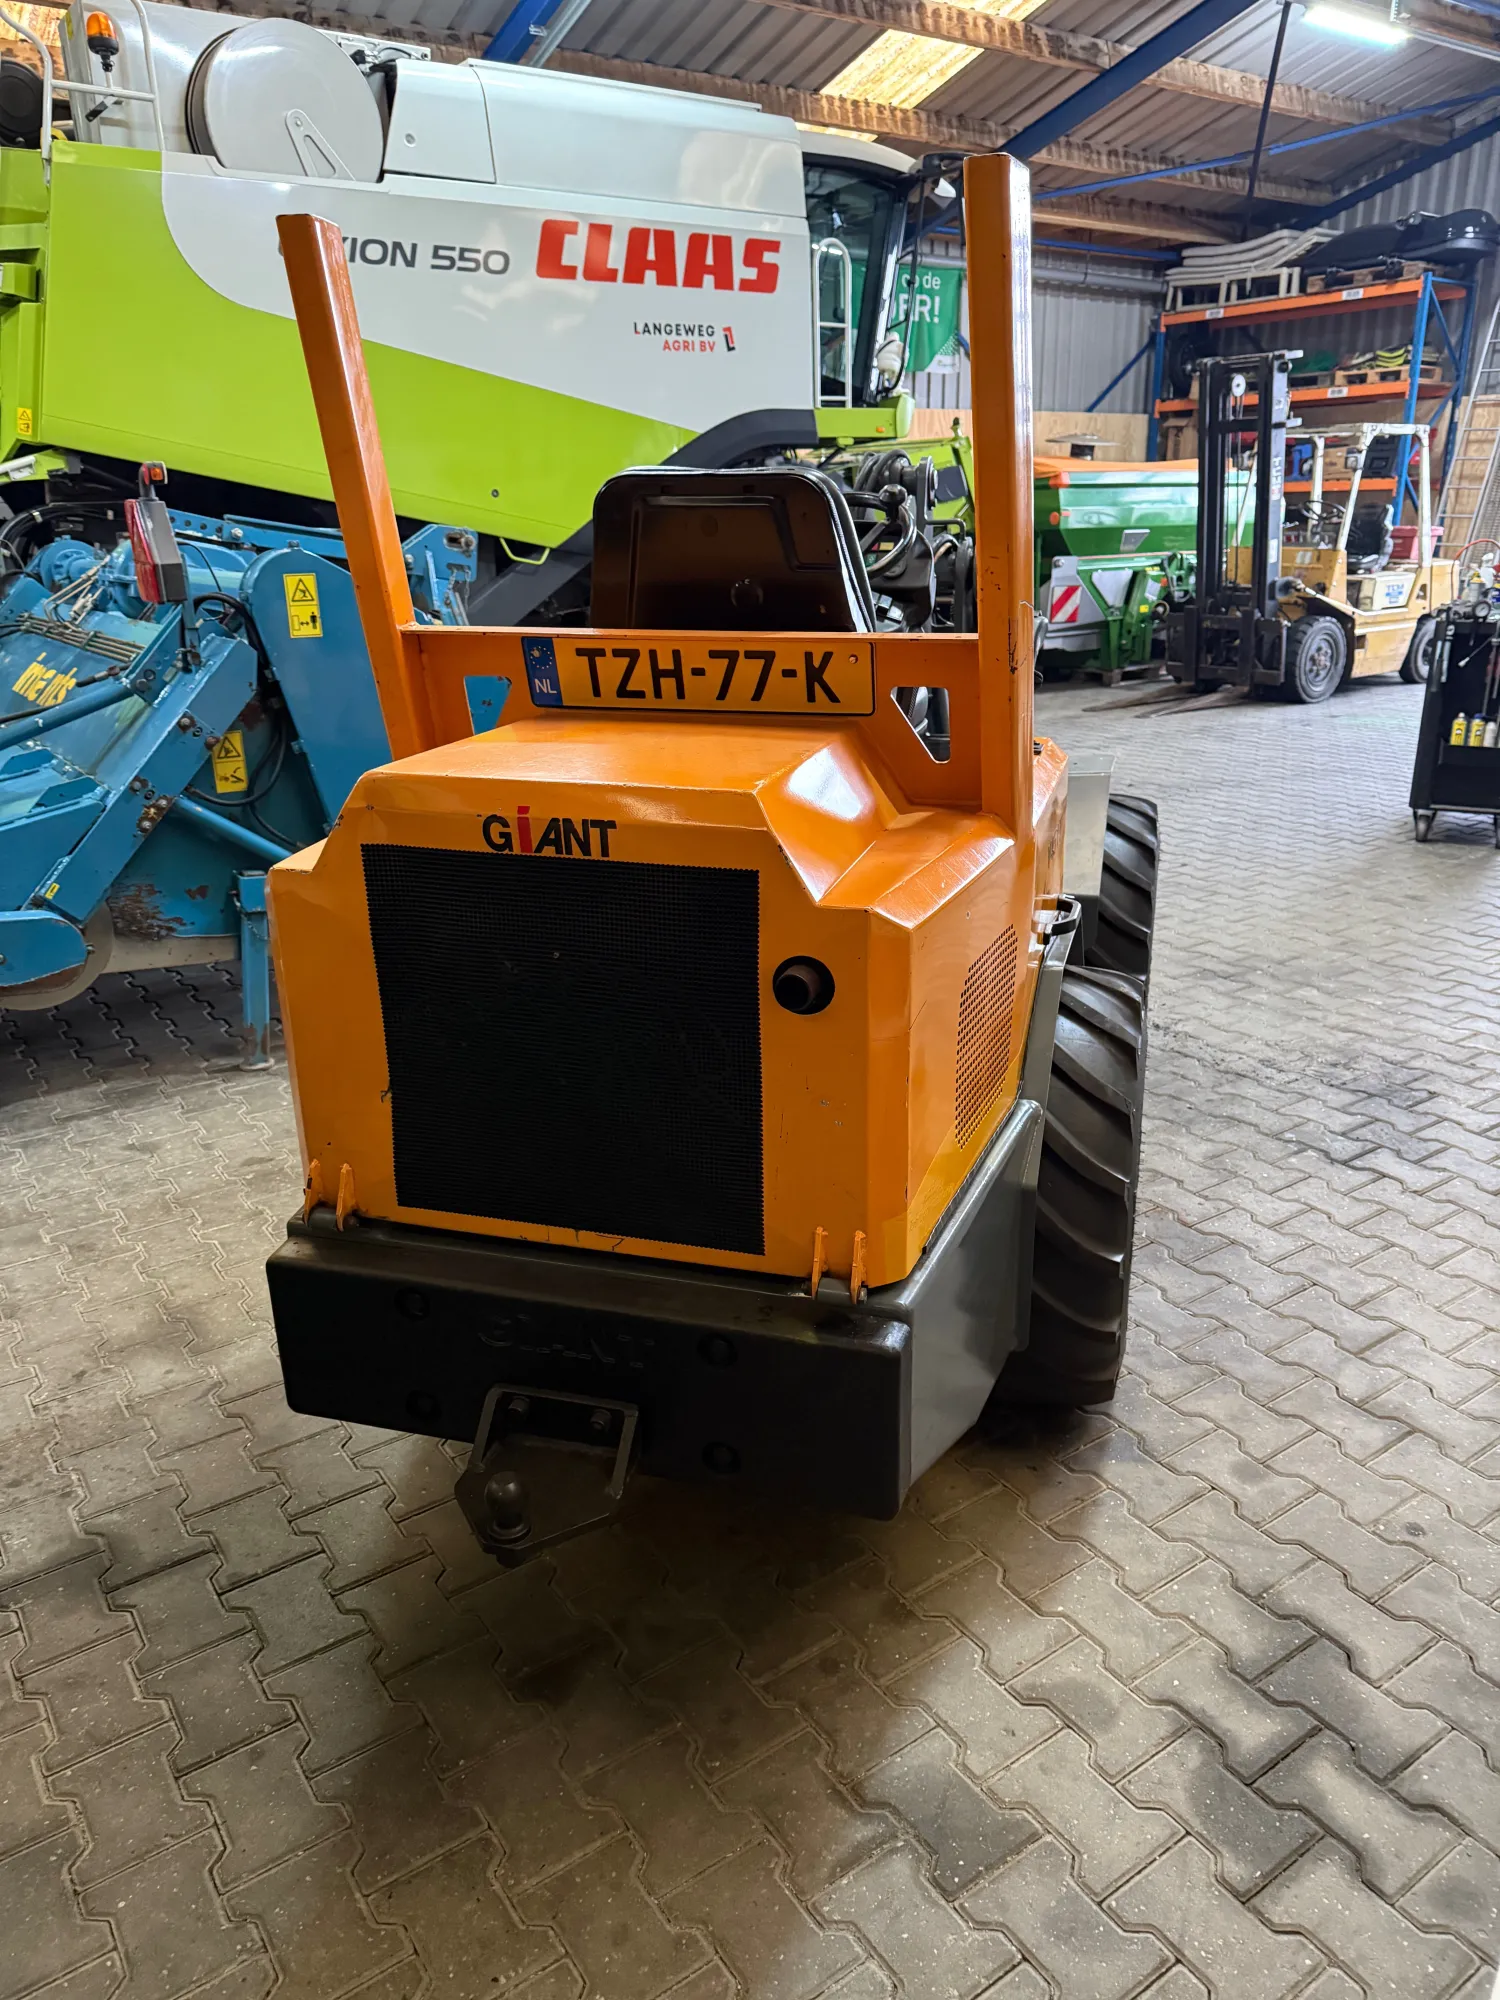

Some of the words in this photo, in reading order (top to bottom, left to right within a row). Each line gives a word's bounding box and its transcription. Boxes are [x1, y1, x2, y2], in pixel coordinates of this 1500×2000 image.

[430, 244, 510, 275] 550
[536, 219, 781, 294] CLAAS
[922, 271, 941, 290] de
[634, 321, 715, 337] LANGEWEG
[662, 339, 695, 352] AGRI
[699, 340, 716, 352] BV
[575, 647, 841, 704] TZH-77-K
[534, 678, 557, 694] NL
